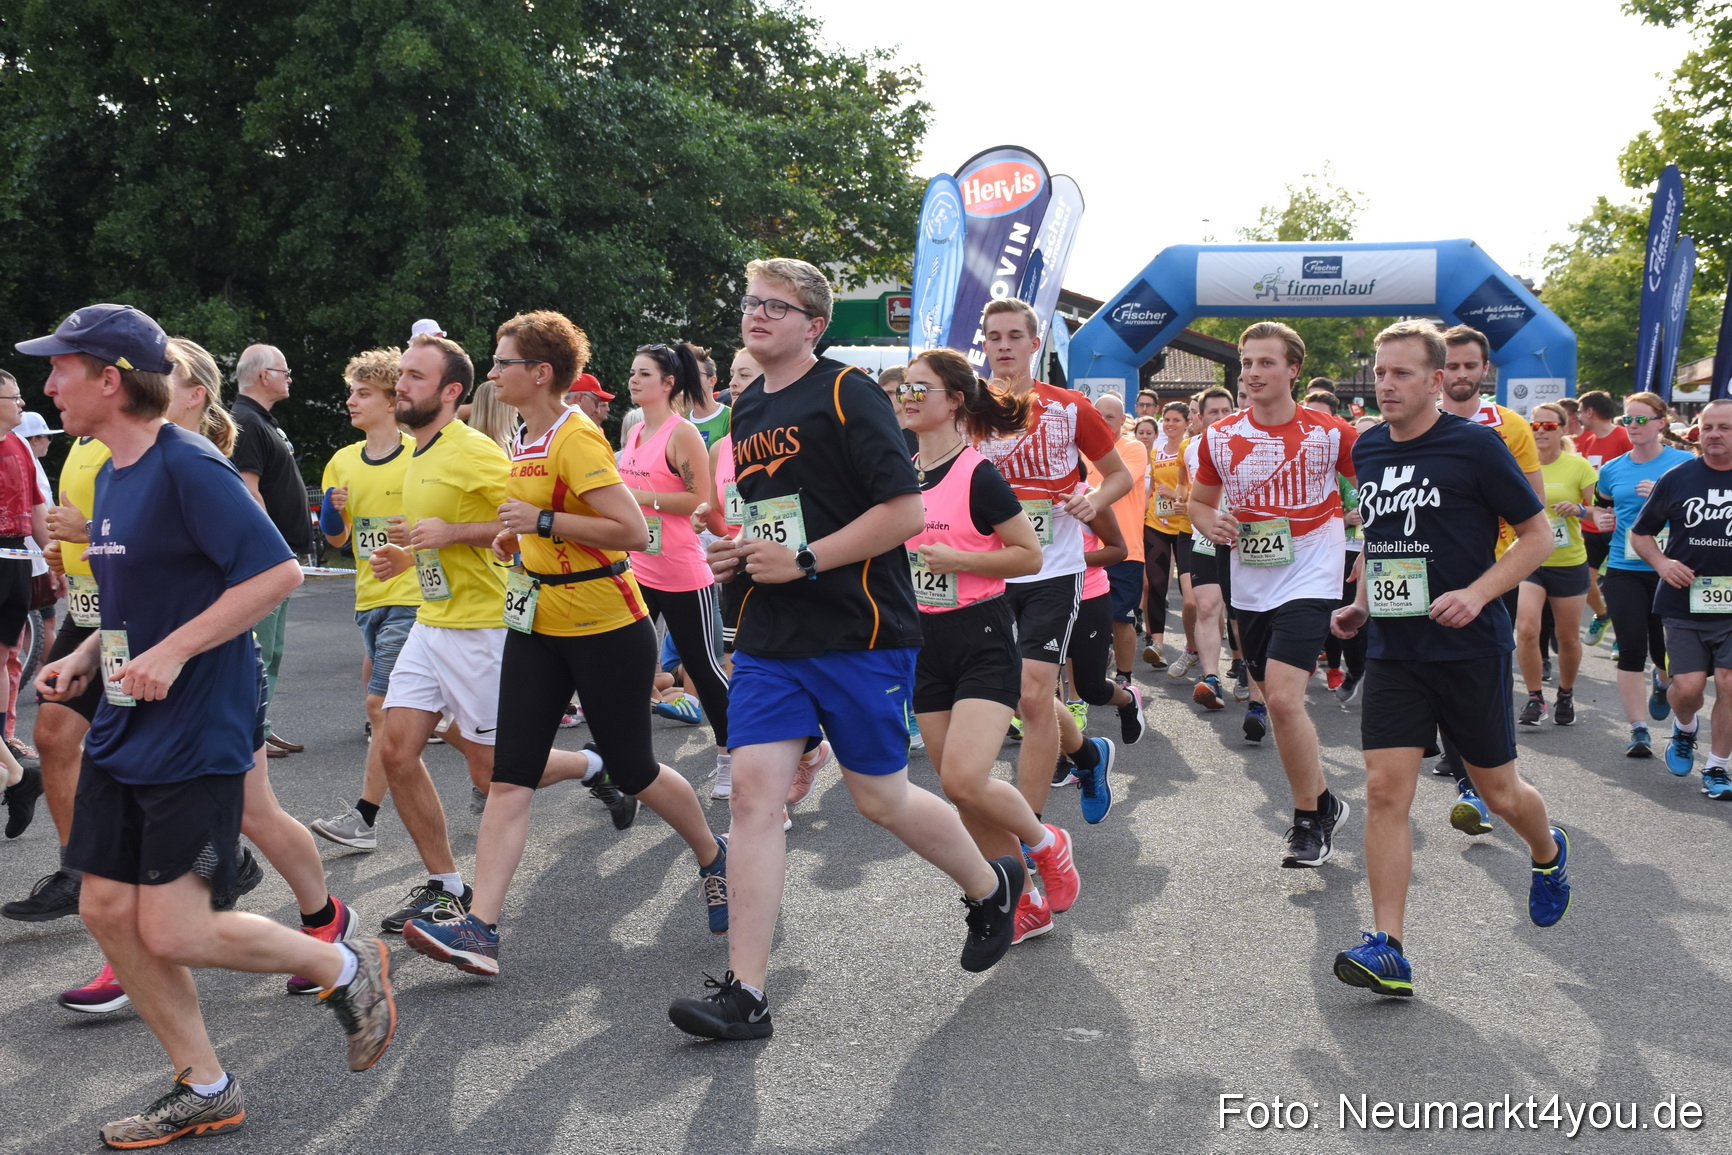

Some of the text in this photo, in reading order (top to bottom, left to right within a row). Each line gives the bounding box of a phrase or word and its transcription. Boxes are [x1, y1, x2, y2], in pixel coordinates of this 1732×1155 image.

[964, 171, 1036, 206] Hervis
[975, 199, 1003, 211] SPORTS
[1050, 206, 1072, 272] AUTOMOBILE
[1653, 188, 1674, 277] Fischer
[988, 222, 1031, 300] OVIN
[1310, 263, 1340, 272] Fischer
[1287, 279, 1376, 295] firmenlauf
[1121, 310, 1167, 320] Fischer
[520, 462, 548, 477] BÖGL
[1158, 500, 1173, 509] 161
[1358, 478, 1440, 536] Burgis
[753, 520, 787, 543] 285
[1241, 536, 1284, 554] 2224
[1367, 540, 1433, 553] Knödelliebe.
[419, 568, 441, 587] 2195
[914, 570, 948, 592] 124
[1374, 580, 1410, 600] 384
[1702, 590, 1732, 603] 390
